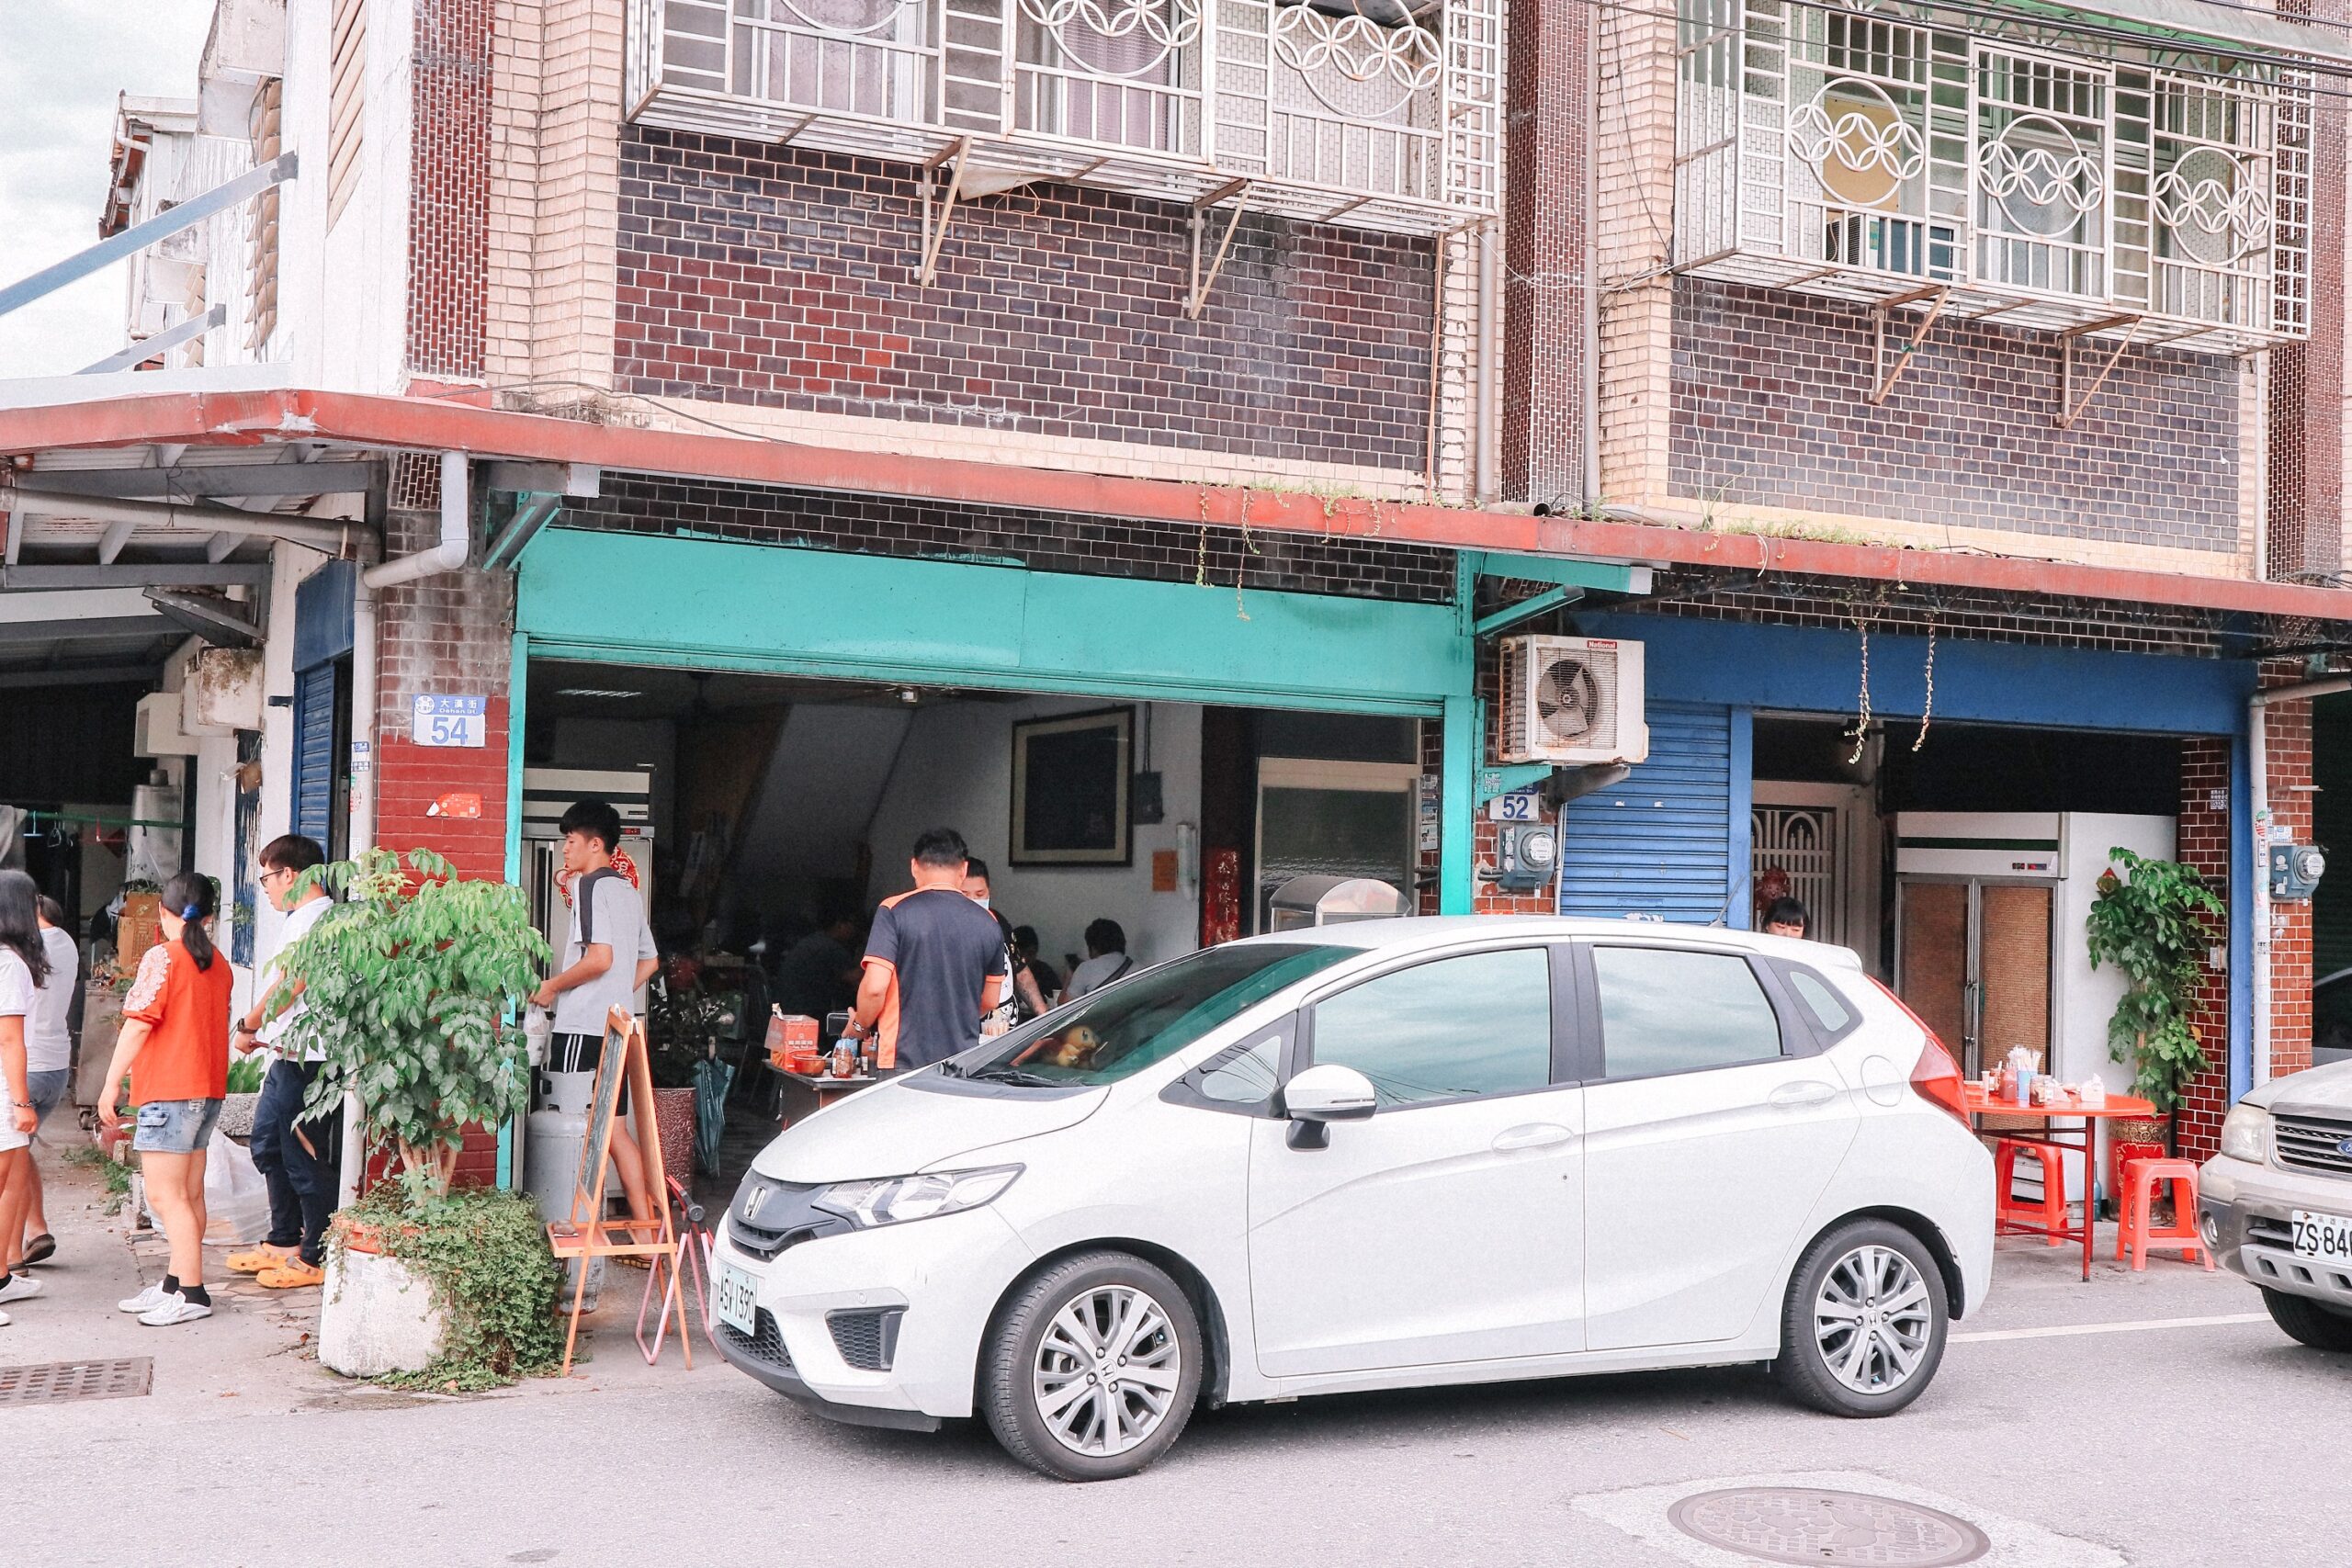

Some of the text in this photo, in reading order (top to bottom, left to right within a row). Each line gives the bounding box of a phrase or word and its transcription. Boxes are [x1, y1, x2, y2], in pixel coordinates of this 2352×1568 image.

[1589, 640, 1616, 649] National
[440, 698, 478, 709] 大漢街
[431, 716, 469, 745] 54
[1502, 795, 1529, 819] 52
[2317, 1215, 2349, 1228] 高雄市
[2293, 1221, 2352, 1258] ZS·84
